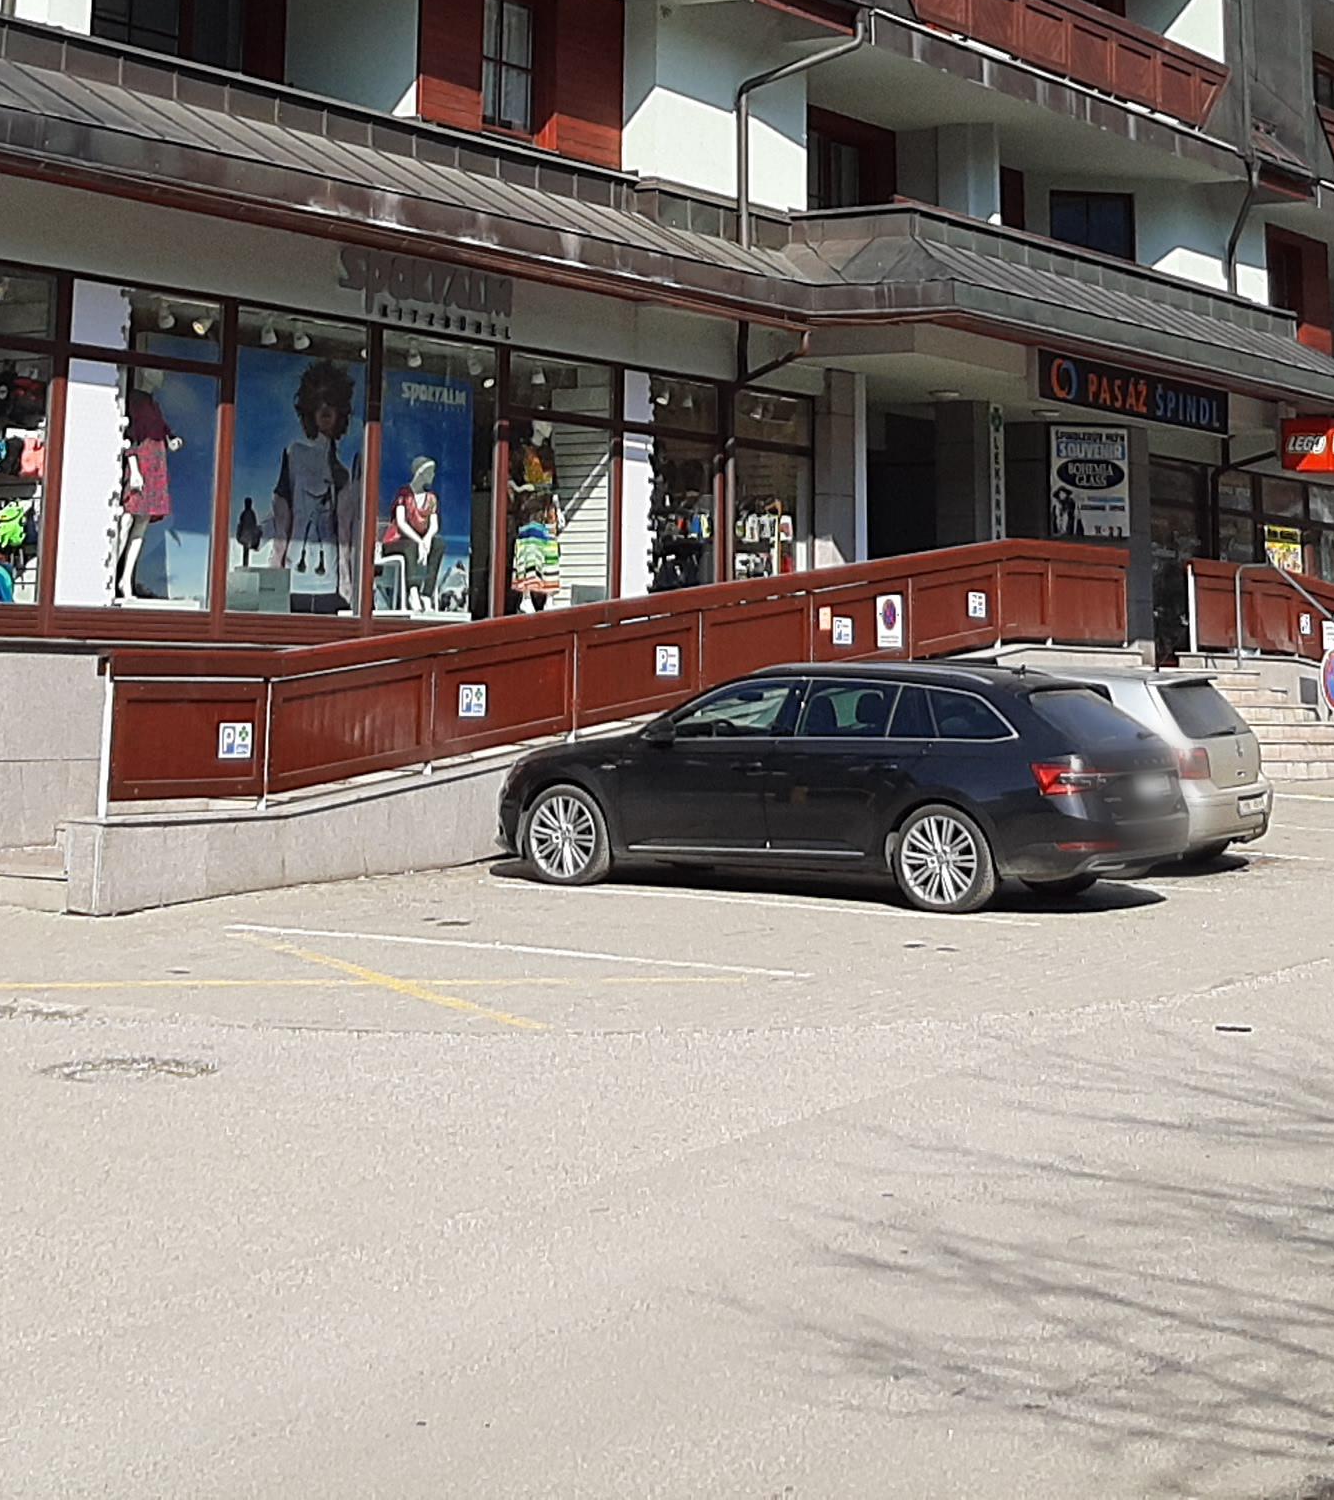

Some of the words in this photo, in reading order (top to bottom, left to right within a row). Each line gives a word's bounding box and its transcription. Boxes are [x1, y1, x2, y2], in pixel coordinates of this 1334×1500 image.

[1088, 373, 1147, 414] PASÁŽ
[1155, 383, 1220, 428] ŠPINDL
[1058, 442, 1123, 460] SOUVENIR
[1287, 435, 1327, 454] LEGO
[1067, 462, 1114, 476] BOHEMIA
[1075, 474, 1107, 487] GLASS
